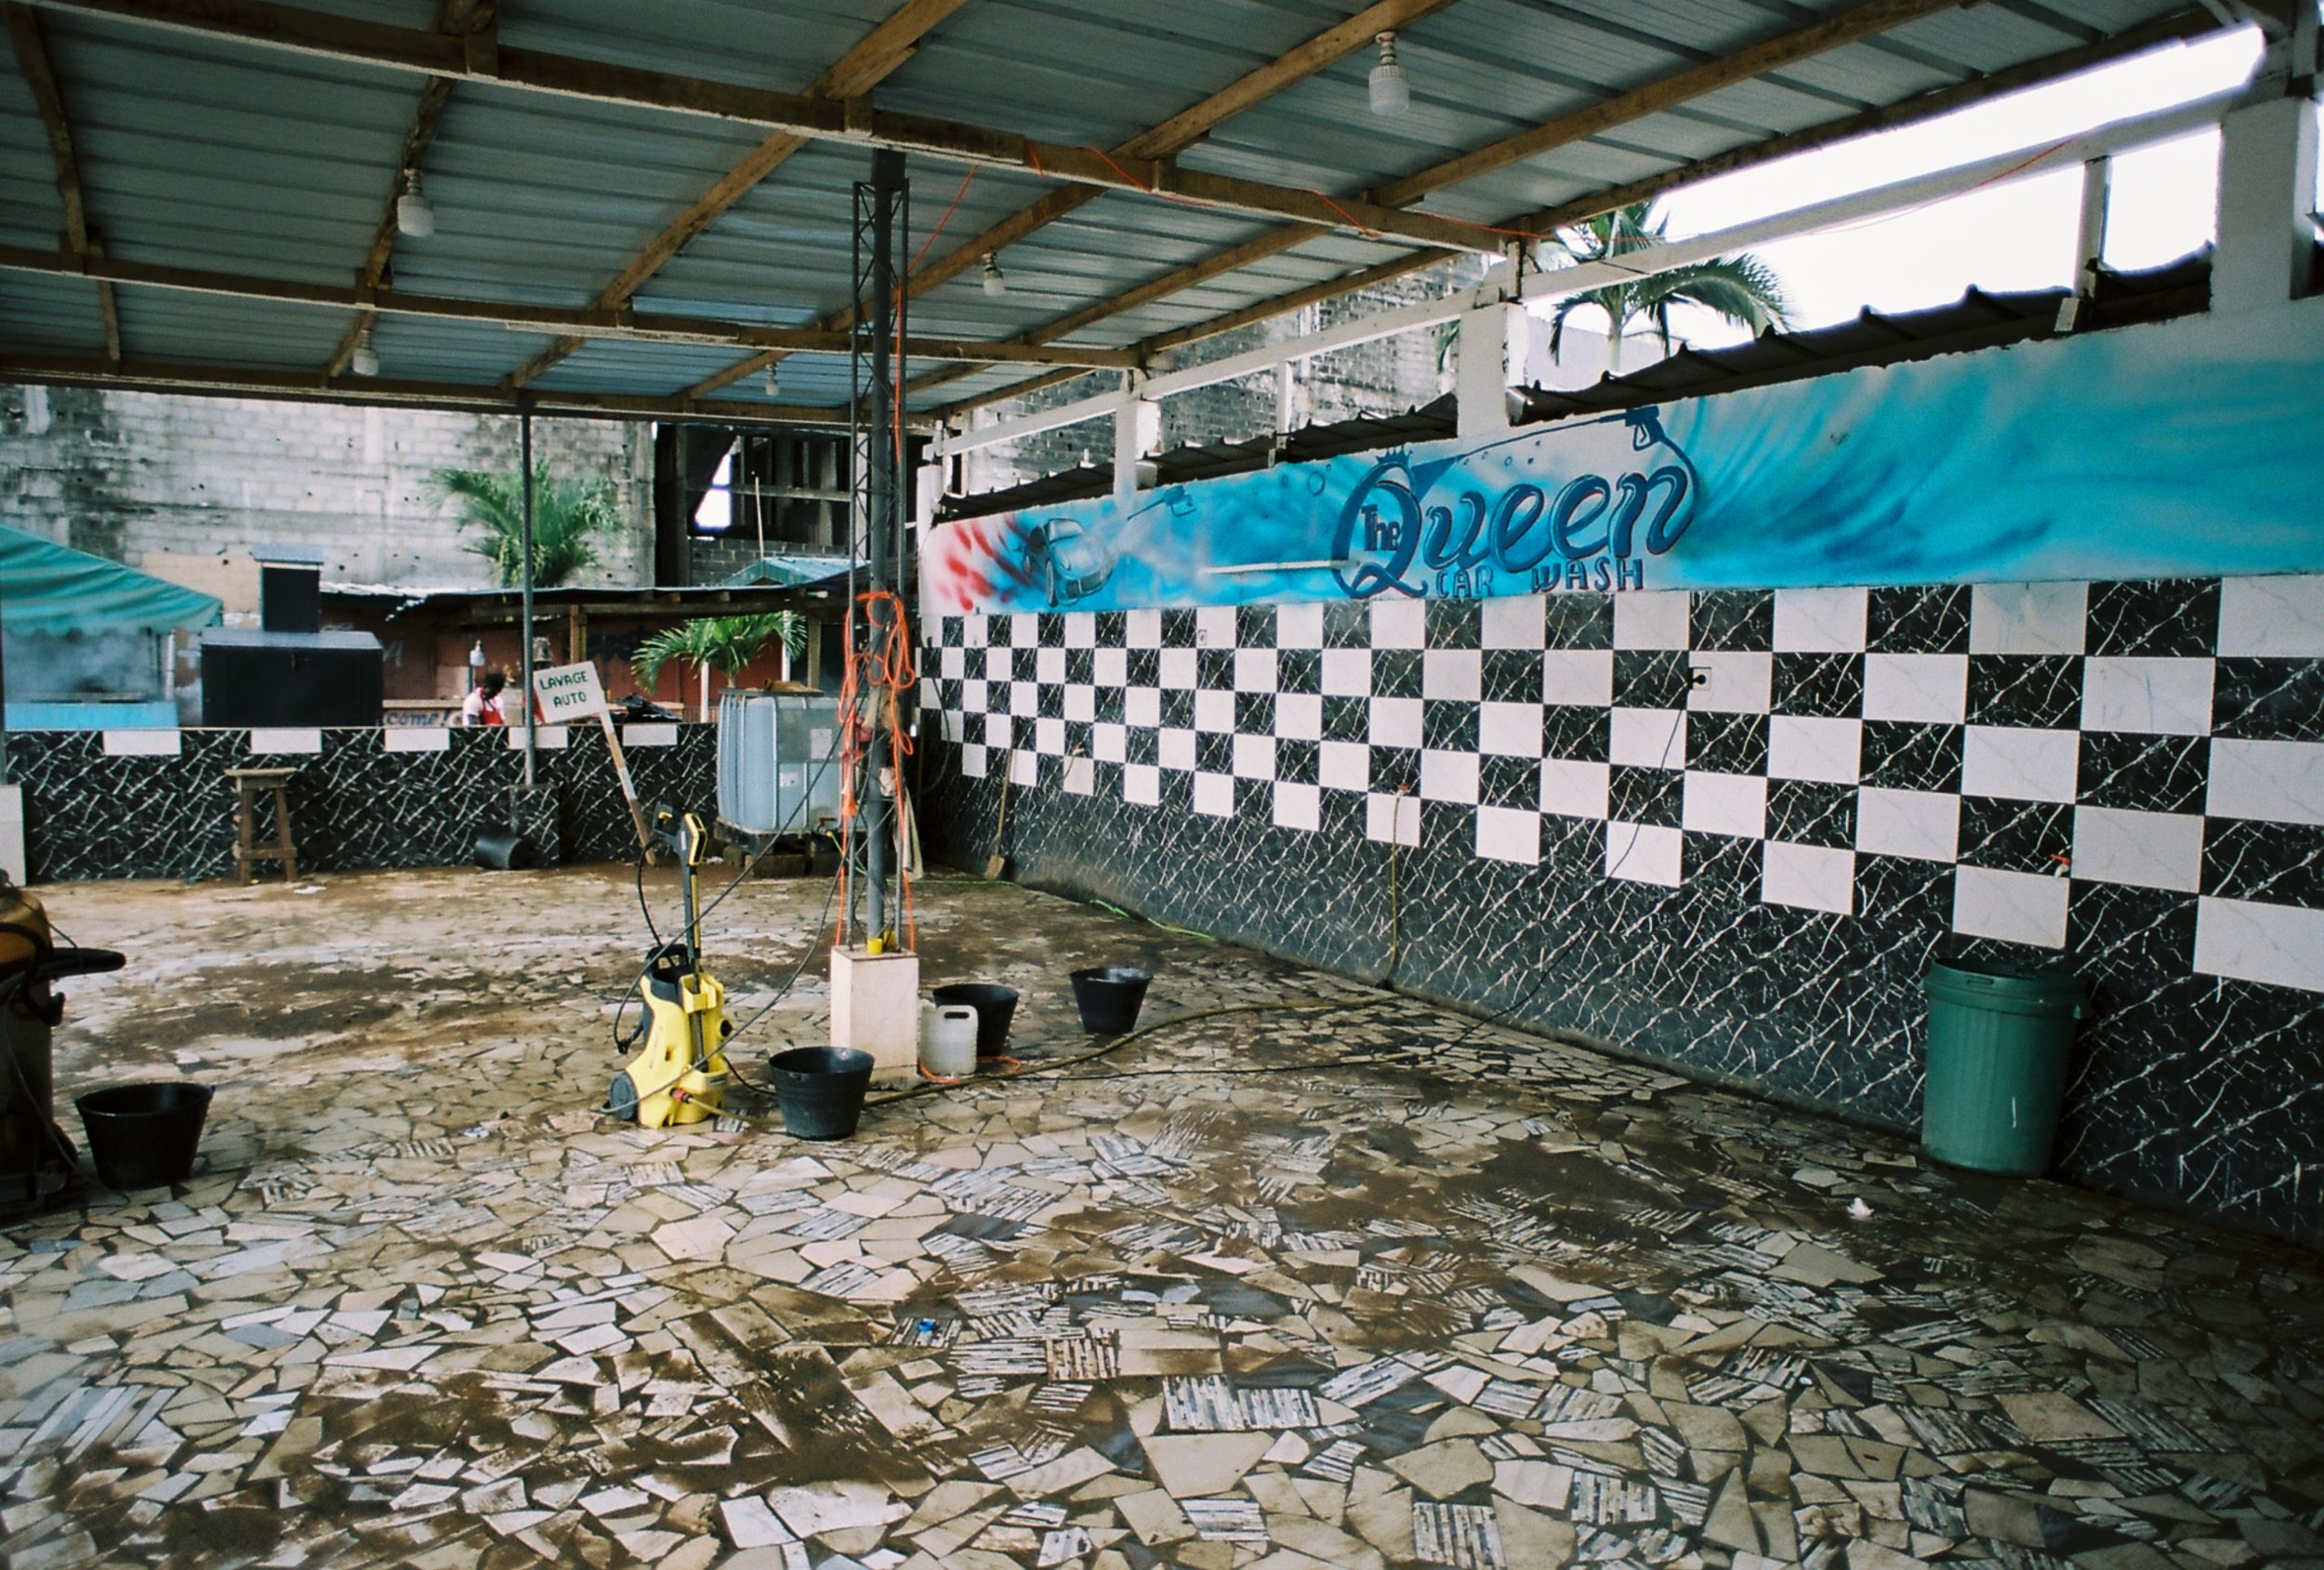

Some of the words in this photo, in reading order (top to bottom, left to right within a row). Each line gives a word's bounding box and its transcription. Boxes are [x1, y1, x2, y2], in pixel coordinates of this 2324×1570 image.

[1331, 462, 1694, 599] Queen
[1361, 504, 1401, 551] The
[1436, 565, 1494, 598] CAR
[1532, 557, 1644, 594] WASH
[539, 670, 588, 690] LAVAGE
[553, 691, 588, 707] AUTO
